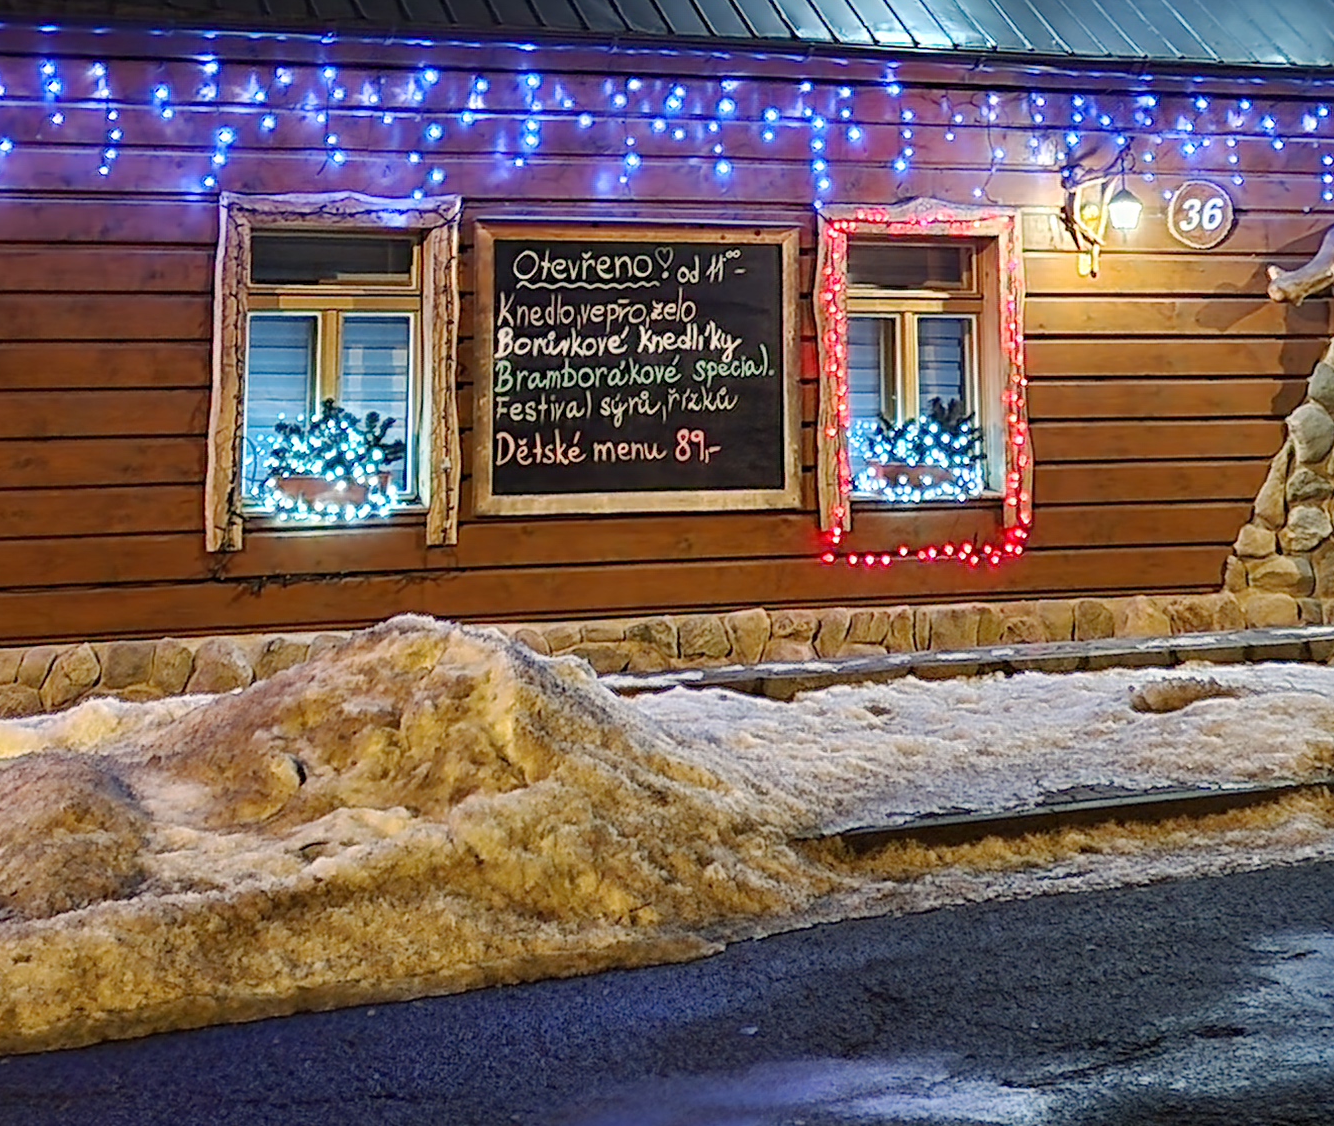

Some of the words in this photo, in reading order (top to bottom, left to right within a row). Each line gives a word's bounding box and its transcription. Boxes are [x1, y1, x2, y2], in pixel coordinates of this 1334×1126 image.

[1179, 198, 1224, 232] 36
[677, 255, 700, 284] od
[494, 355, 682, 392] Bramborákové
[496, 390, 593, 424] Festival
[495, 428, 587, 466] Dětské
[593, 440, 668, 463] menu
